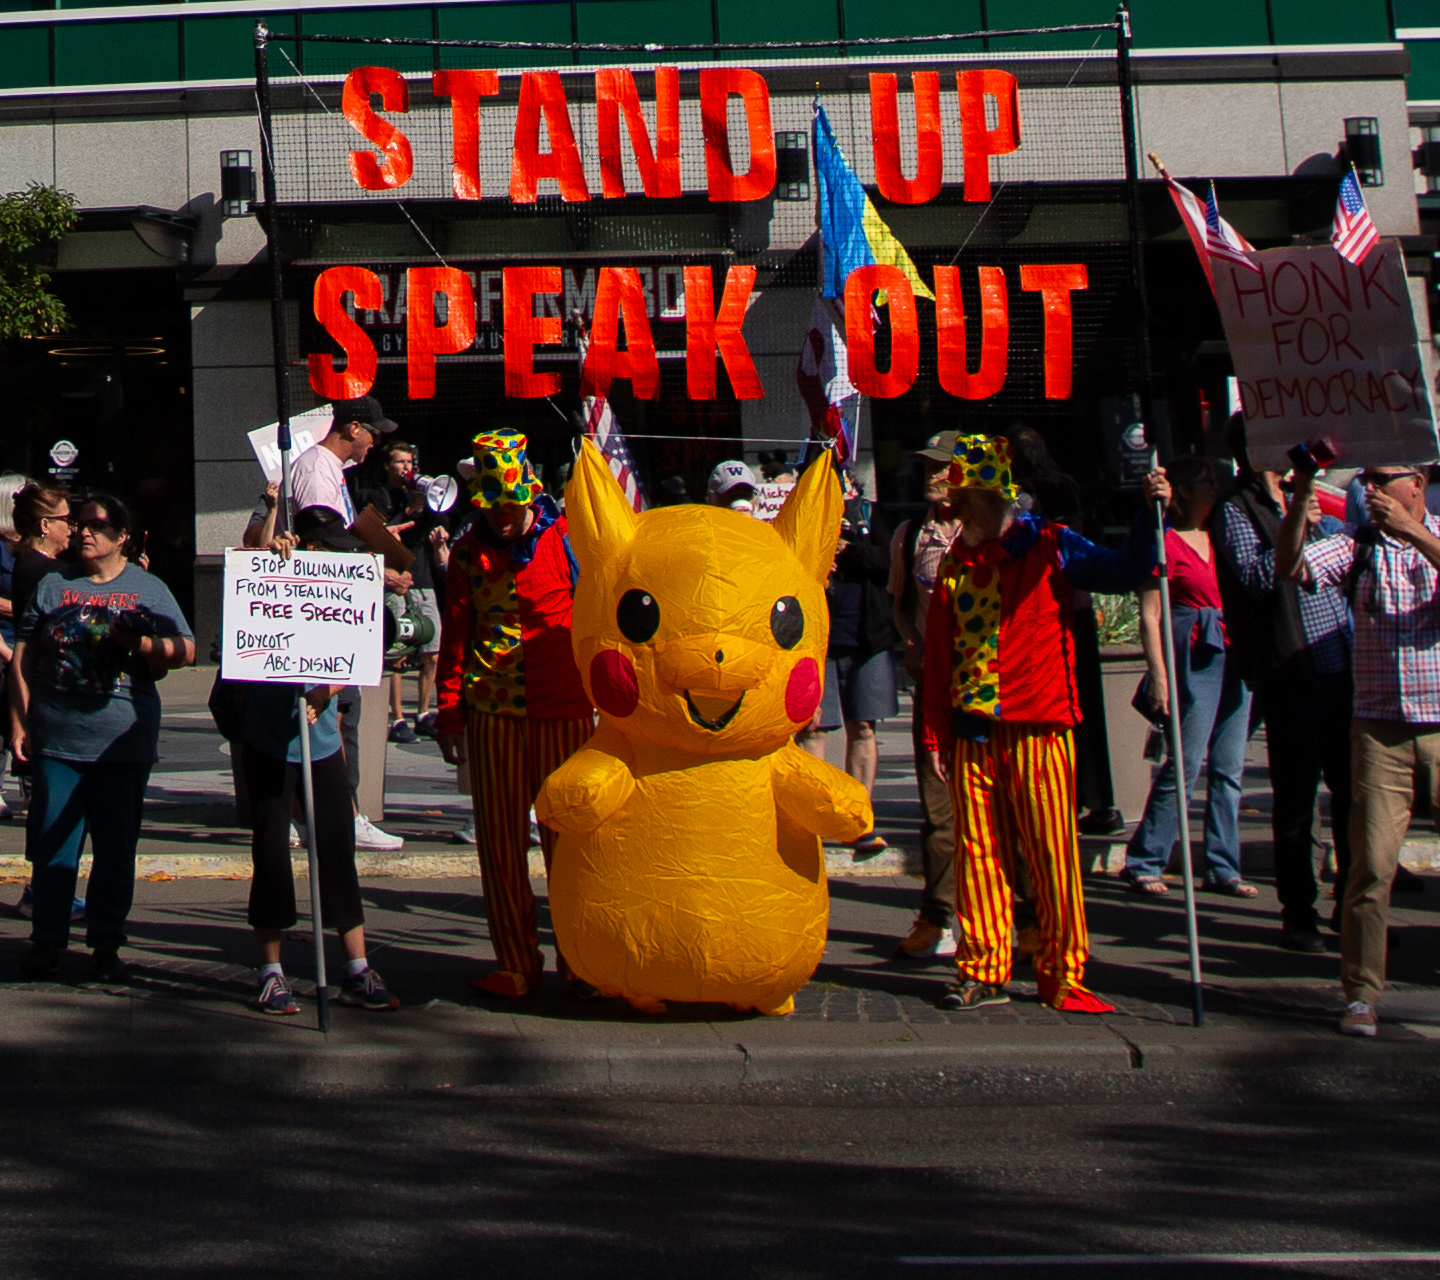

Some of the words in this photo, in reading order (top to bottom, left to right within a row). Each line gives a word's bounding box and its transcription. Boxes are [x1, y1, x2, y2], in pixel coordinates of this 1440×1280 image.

[341, 65, 779, 204] STAND
[868, 68, 1022, 206] UP
[1230, 253, 1401, 319] HONK
[307, 264, 766, 402] SPEAK
[843, 262, 1090, 401] OUT
[1271, 312, 1365, 366] FOR
[1239, 366, 1422, 422] DEMOCRACY
[726, 466, 744, 477] W
[757, 486, 793, 499] Mick
[251, 555, 287, 575] STOP
[293, 557, 376, 583] BILLIONAIRES
[59, 589, 141, 611] AVENGERS
[235, 578, 278, 599] FROM
[284, 583, 353, 604] STEALING
[249, 600, 294, 620] FREE
[235, 629, 296, 651] BOYCOTT
[263, 653, 356, 675] ABC-DISNEY
